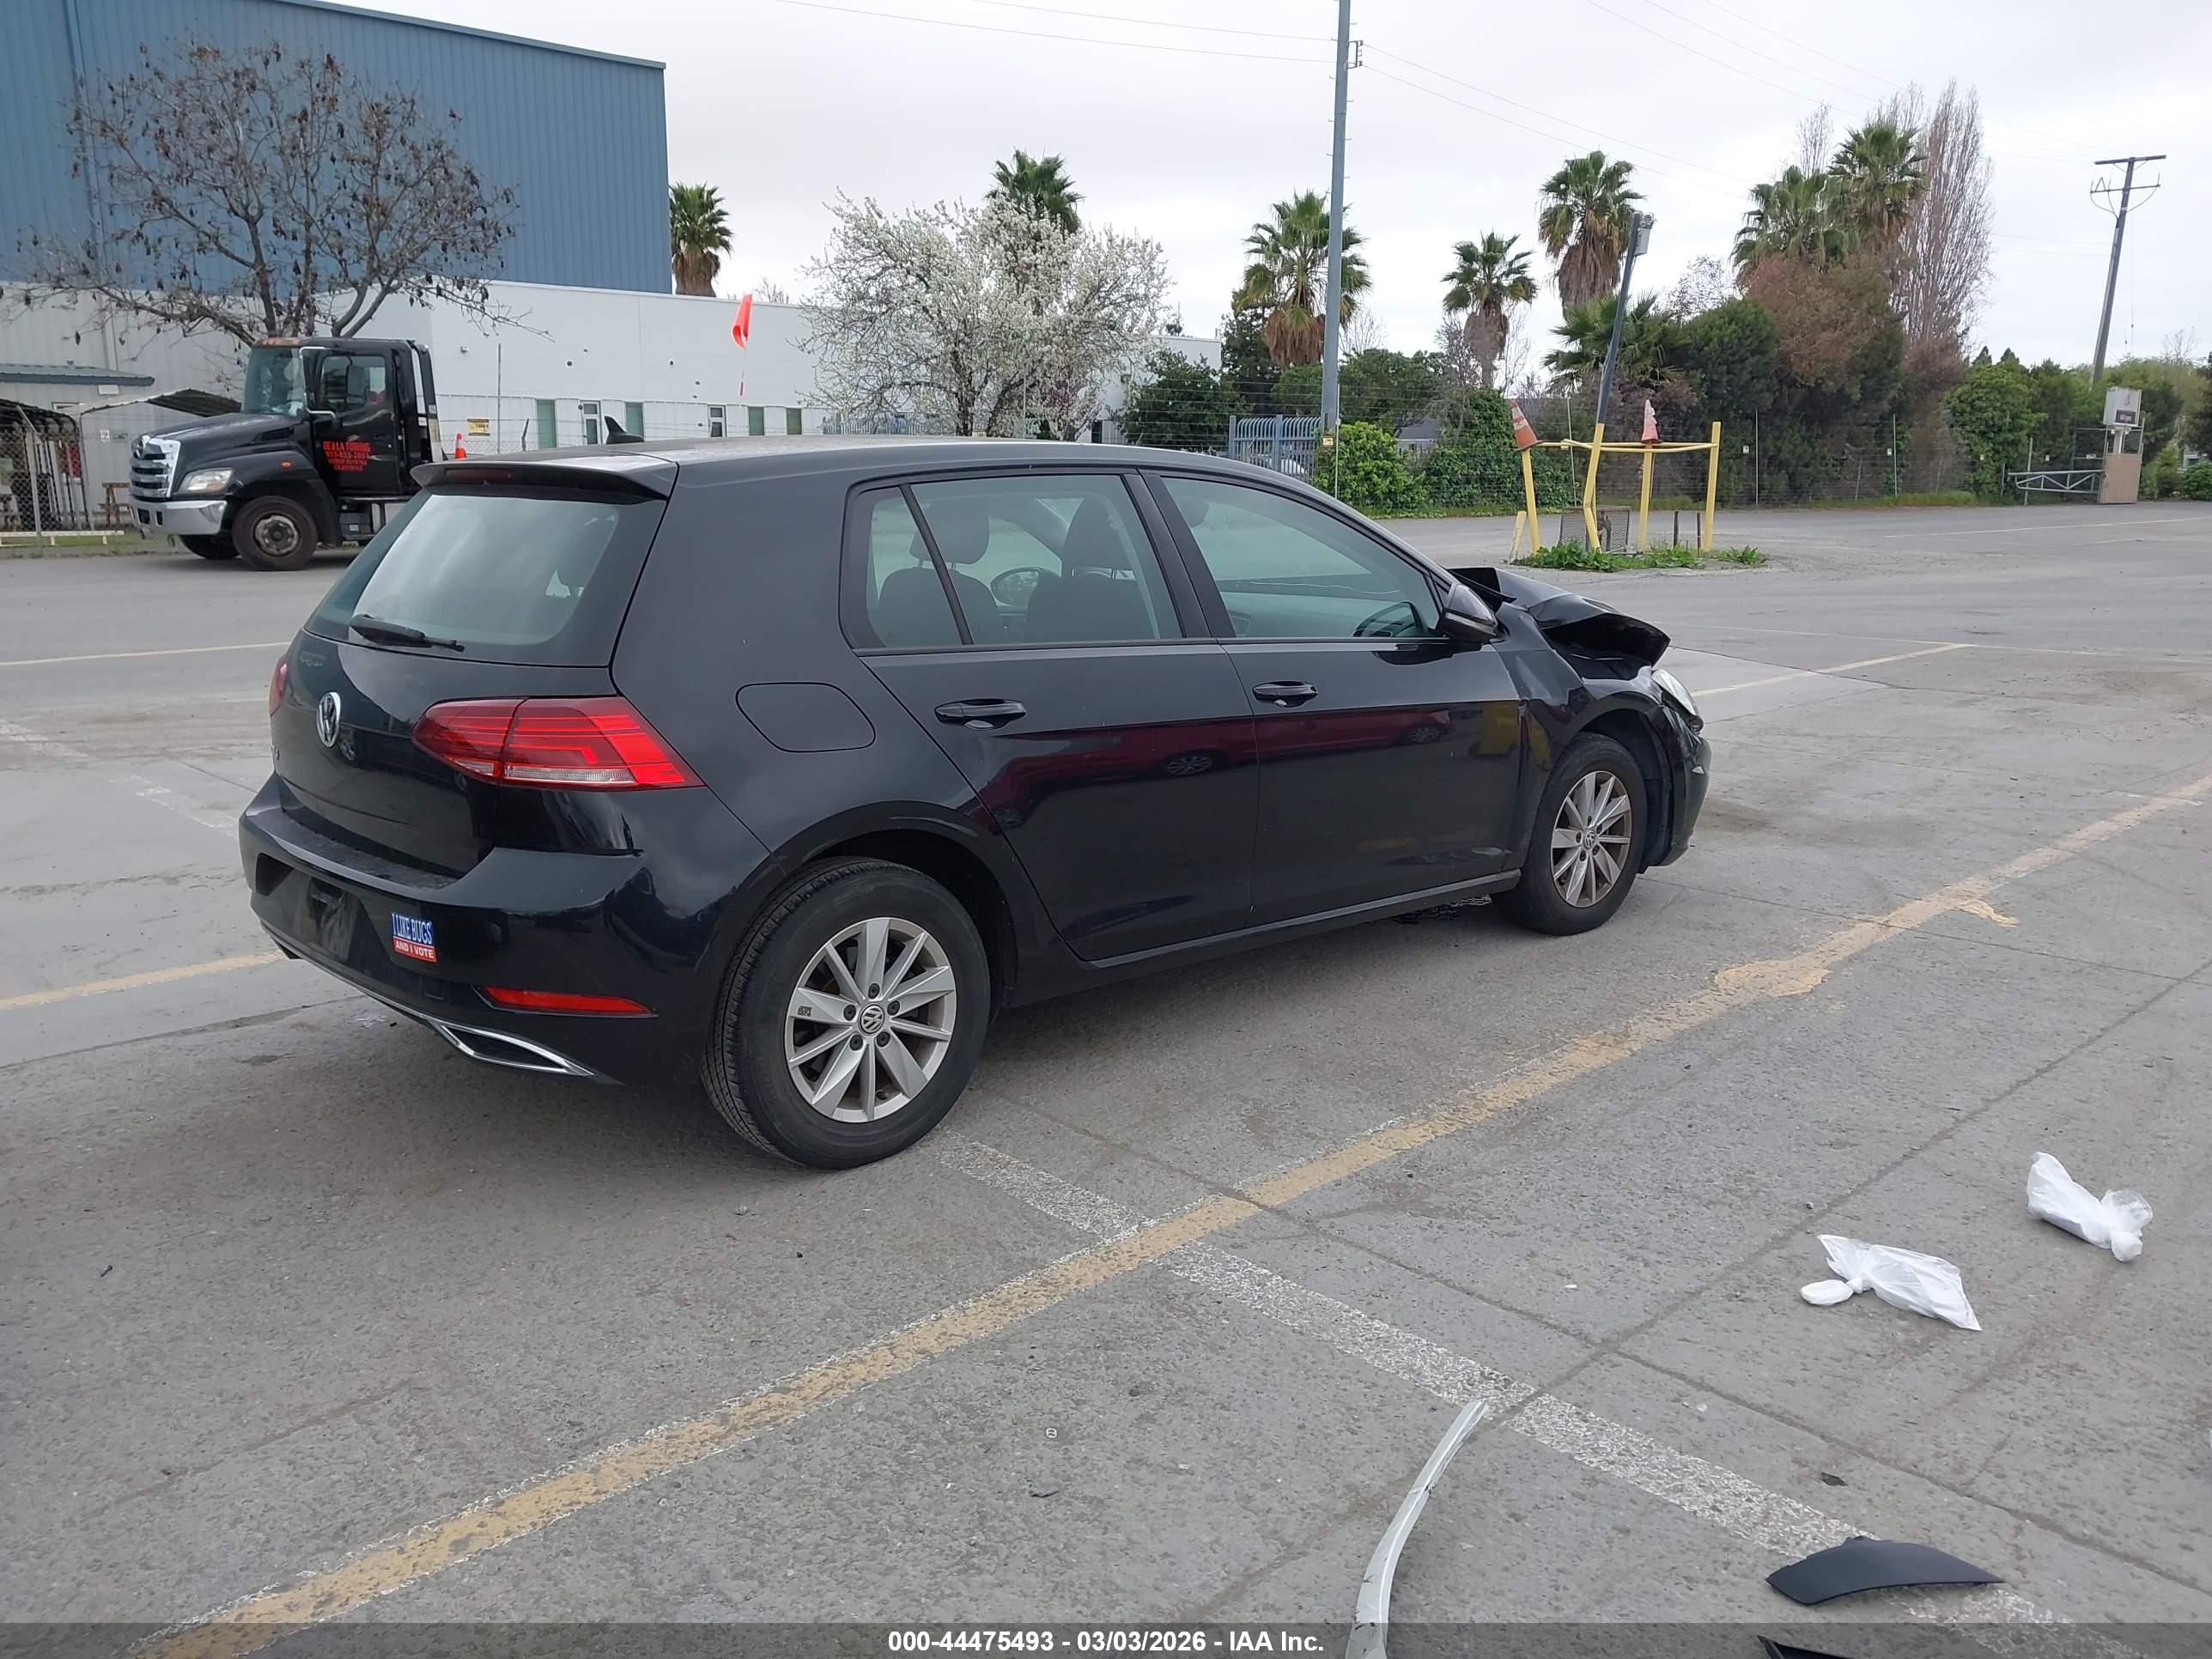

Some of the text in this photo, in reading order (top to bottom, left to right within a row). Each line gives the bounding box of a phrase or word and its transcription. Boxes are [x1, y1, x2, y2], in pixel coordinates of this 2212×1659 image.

[392, 913, 433, 945] I LIKE BUGS
[395, 940, 409, 951] AND
[413, 945, 434, 959] VOTE
